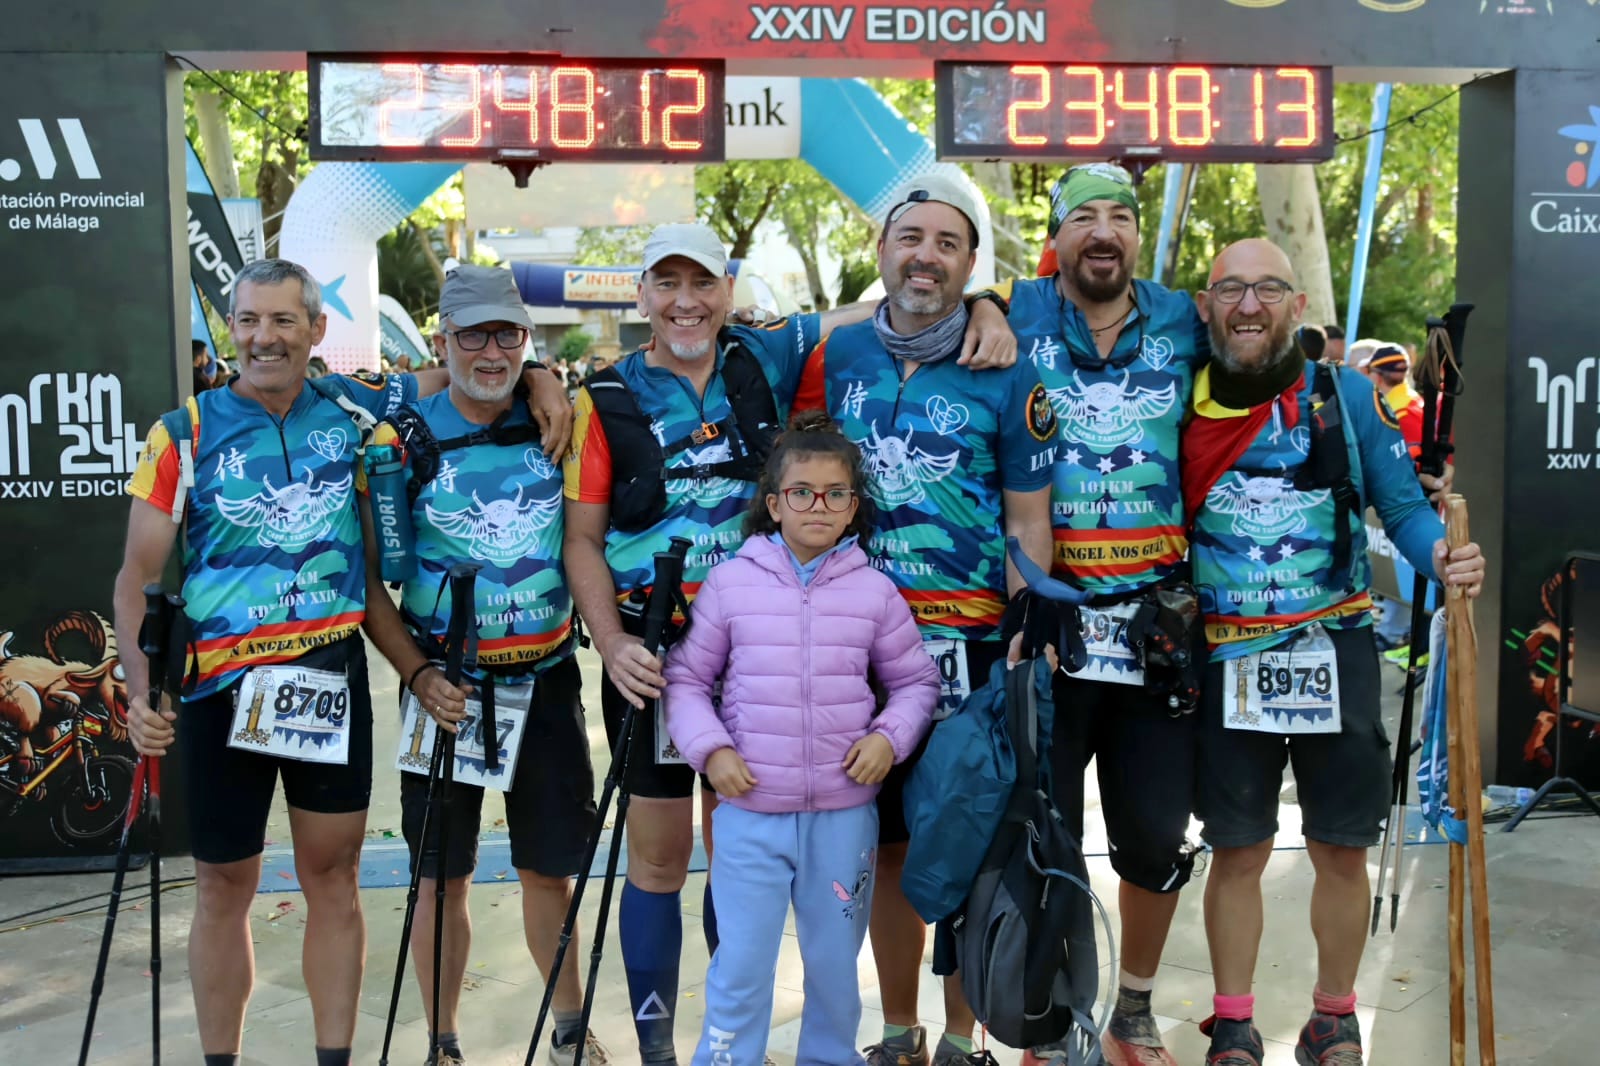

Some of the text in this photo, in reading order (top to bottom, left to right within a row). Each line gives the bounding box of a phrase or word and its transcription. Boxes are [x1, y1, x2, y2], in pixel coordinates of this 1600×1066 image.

[750, 2, 1047, 43] XXIV EDICIÓN
[1006, 65, 1317, 147] 23:48:13
[60, 191, 145, 208] Provincial
[8, 212, 100, 232] de Málaga
[1530, 200, 1600, 233] Caix
[1547, 453, 1591, 470] XXIV
[0, 480, 54, 499] XXIV
[1079, 481, 1135, 495] 101KM
[1053, 498, 1155, 515] EDICIÓN XXIV
[376, 492, 401, 549] SPORT
[868, 535, 909, 554] 01KM
[1110, 545, 1139, 560] NOS
[1247, 569, 1299, 584] 101KM
[486, 589, 537, 607] 101KM
[1226, 586, 1286, 603] EDICIÓN
[1257, 666, 1332, 696] 8979
[274, 683, 347, 721] 8709
